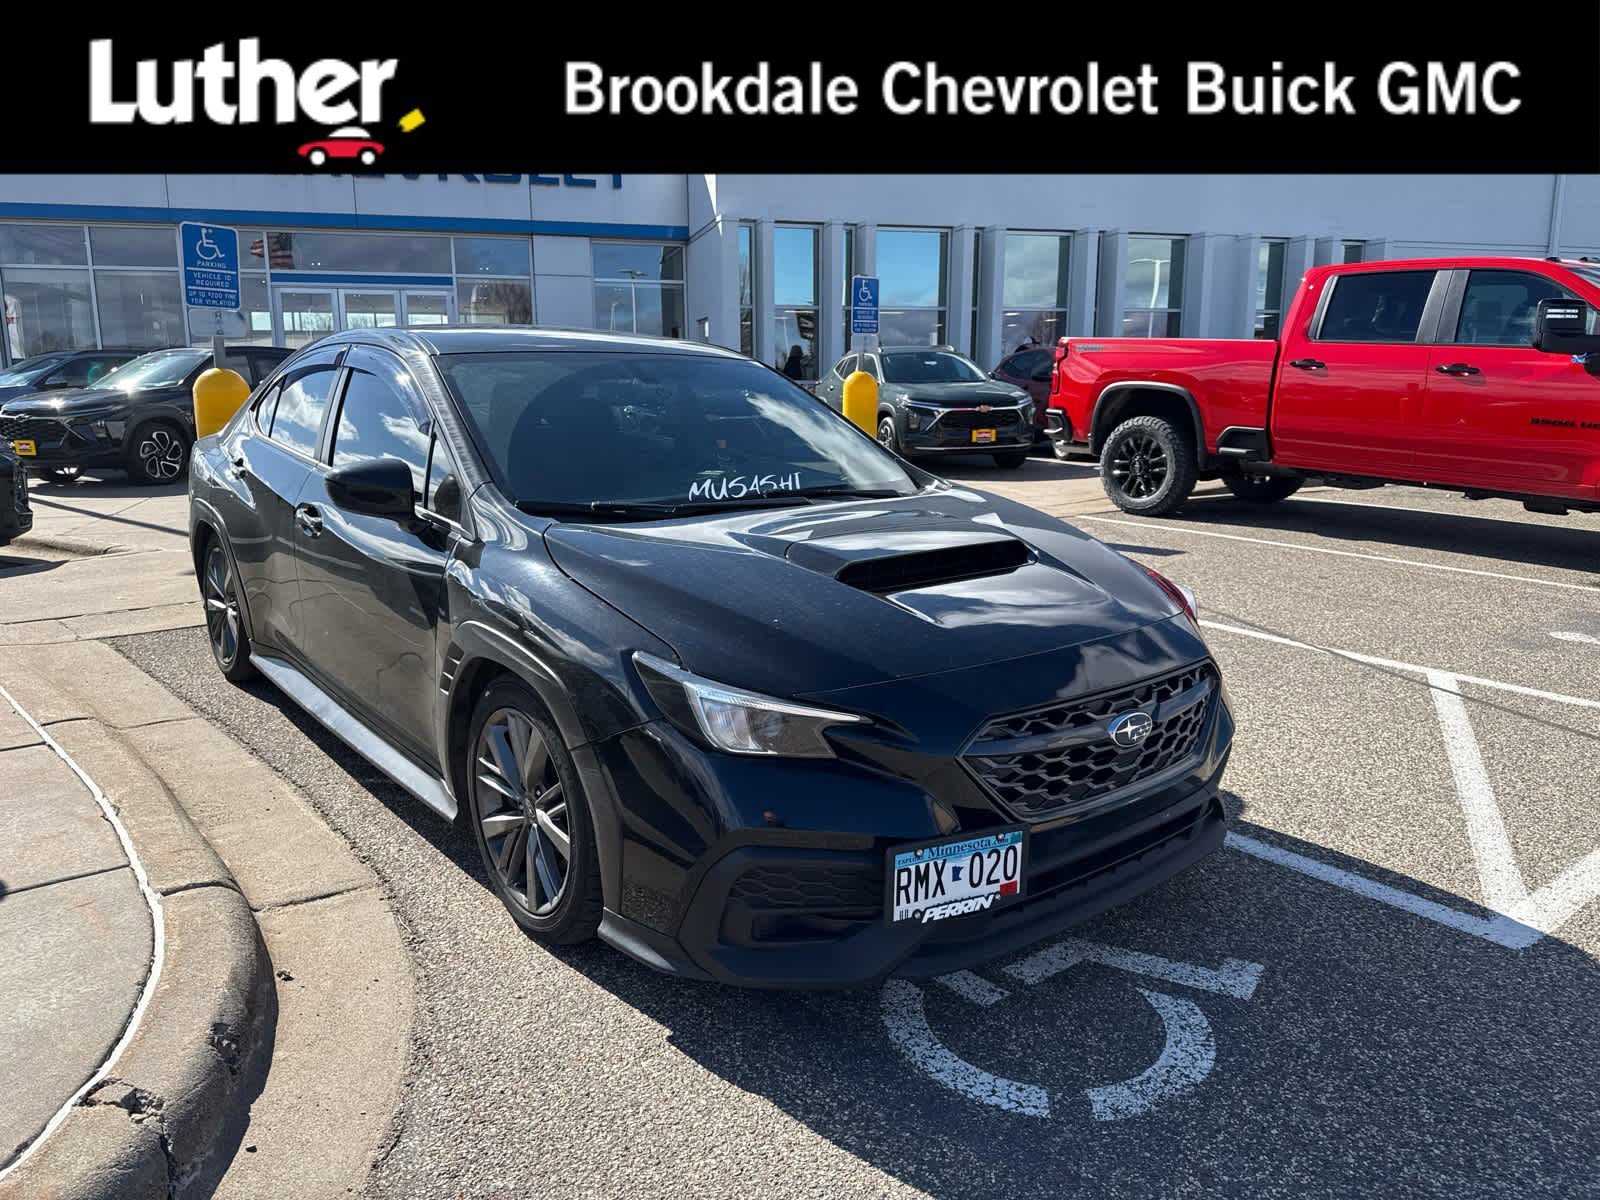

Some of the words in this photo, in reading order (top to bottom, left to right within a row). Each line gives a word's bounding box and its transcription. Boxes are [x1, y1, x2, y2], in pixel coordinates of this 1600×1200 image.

[196, 260, 227, 269] PARKING
[193, 271, 221, 280] VEHICLE
[195, 279, 230, 288] REQUIRED
[688, 471, 801, 502] MUSASHI
[895, 857, 948, 907] RMX
[968, 845, 1019, 889] 020
[921, 893, 995, 924] PERRIN
